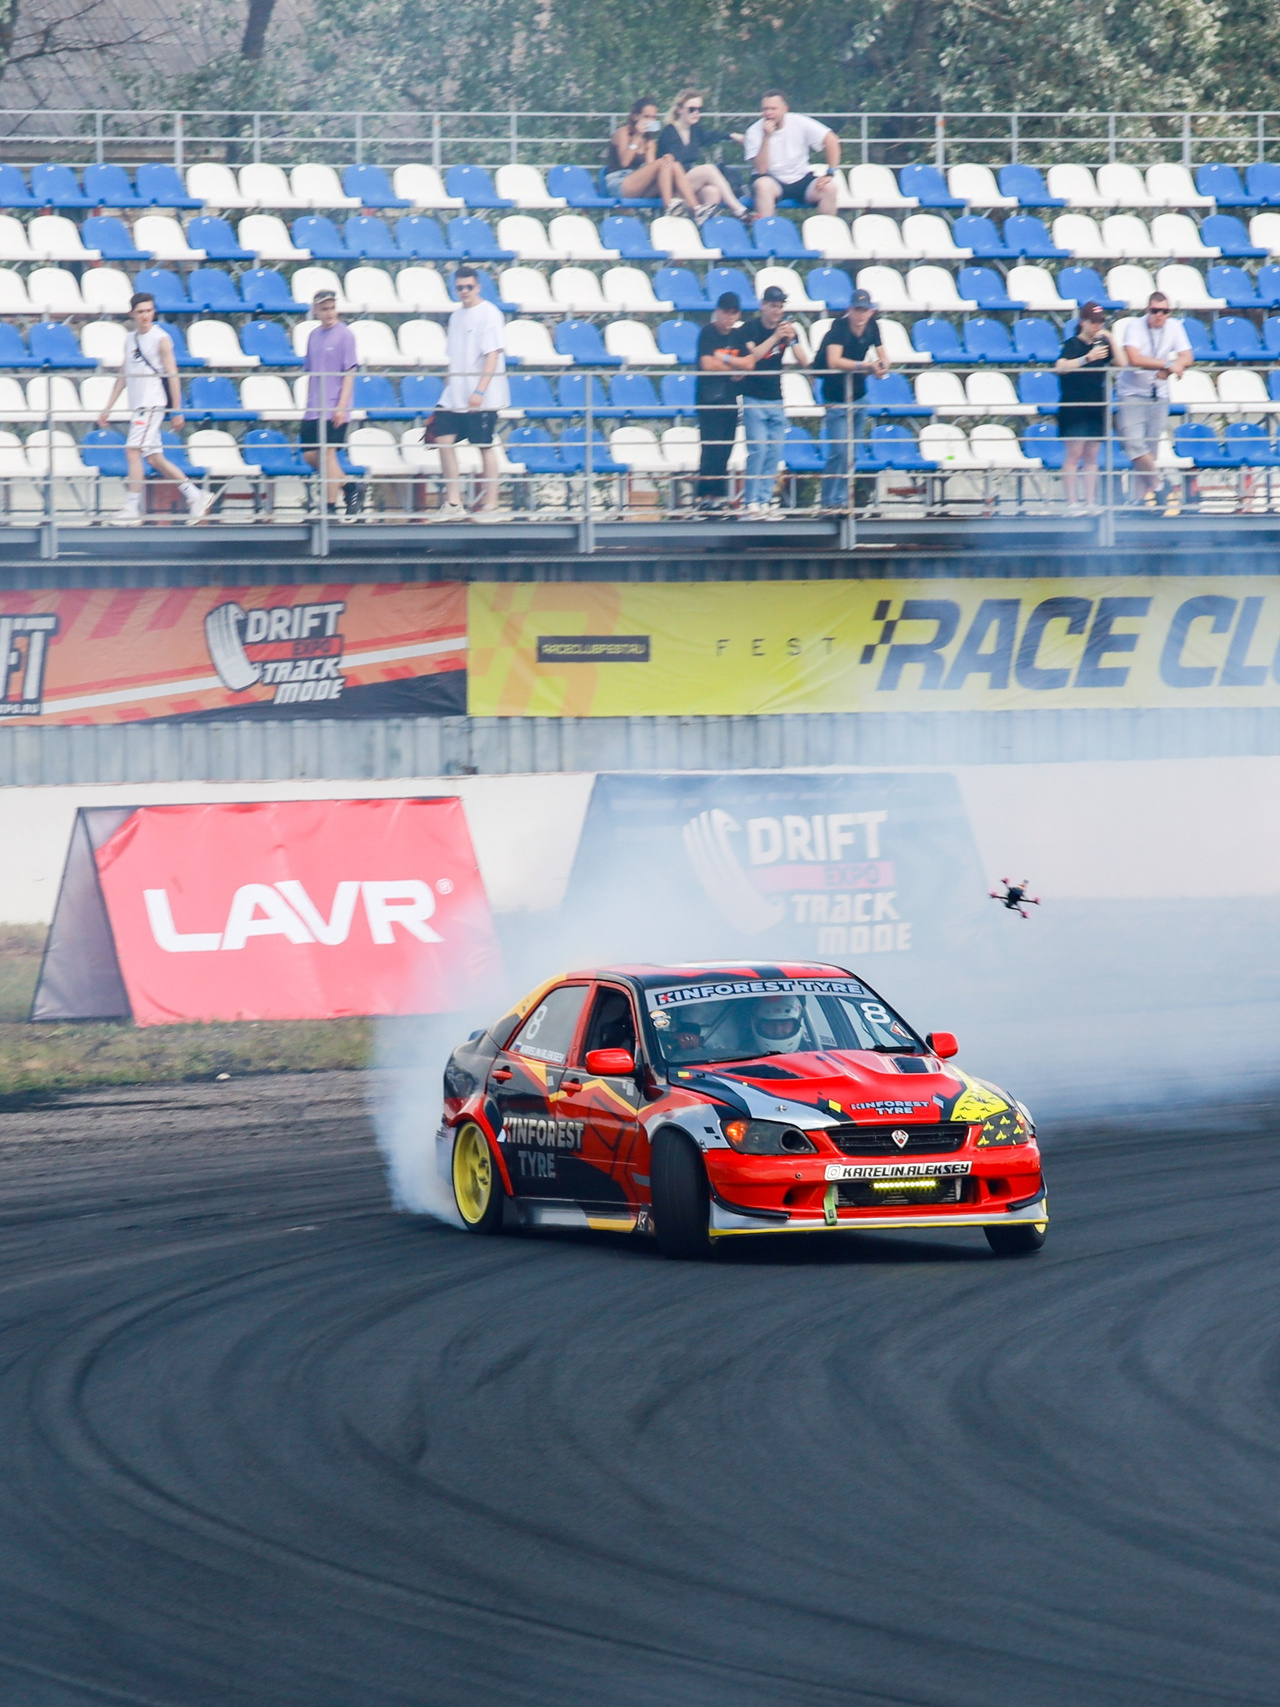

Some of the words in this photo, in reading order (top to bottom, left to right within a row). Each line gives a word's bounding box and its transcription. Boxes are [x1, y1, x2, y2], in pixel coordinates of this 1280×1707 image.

[245, 602, 345, 643] DRIFT
[716, 637, 837, 657] FEST
[875, 596, 1154, 692] RACE
[262, 657, 340, 684] TRACK
[273, 678, 346, 705] MODE
[747, 809, 888, 866] DRIFT
[825, 864, 881, 887] EXPO
[790, 890, 900, 924] TRACK
[817, 922, 913, 956] MODE
[656, 980, 795, 1007] KINFOREST
[799, 980, 866, 996] TYRE
[526, 1005, 548, 1040] 8
[860, 1002, 891, 1025] 8
[850, 1100, 930, 1111] KINFOREST
[874, 1107, 914, 1116] TYRE
[497, 1116, 585, 1149] KINFOREST
[518, 1150, 556, 1178] TYRE
